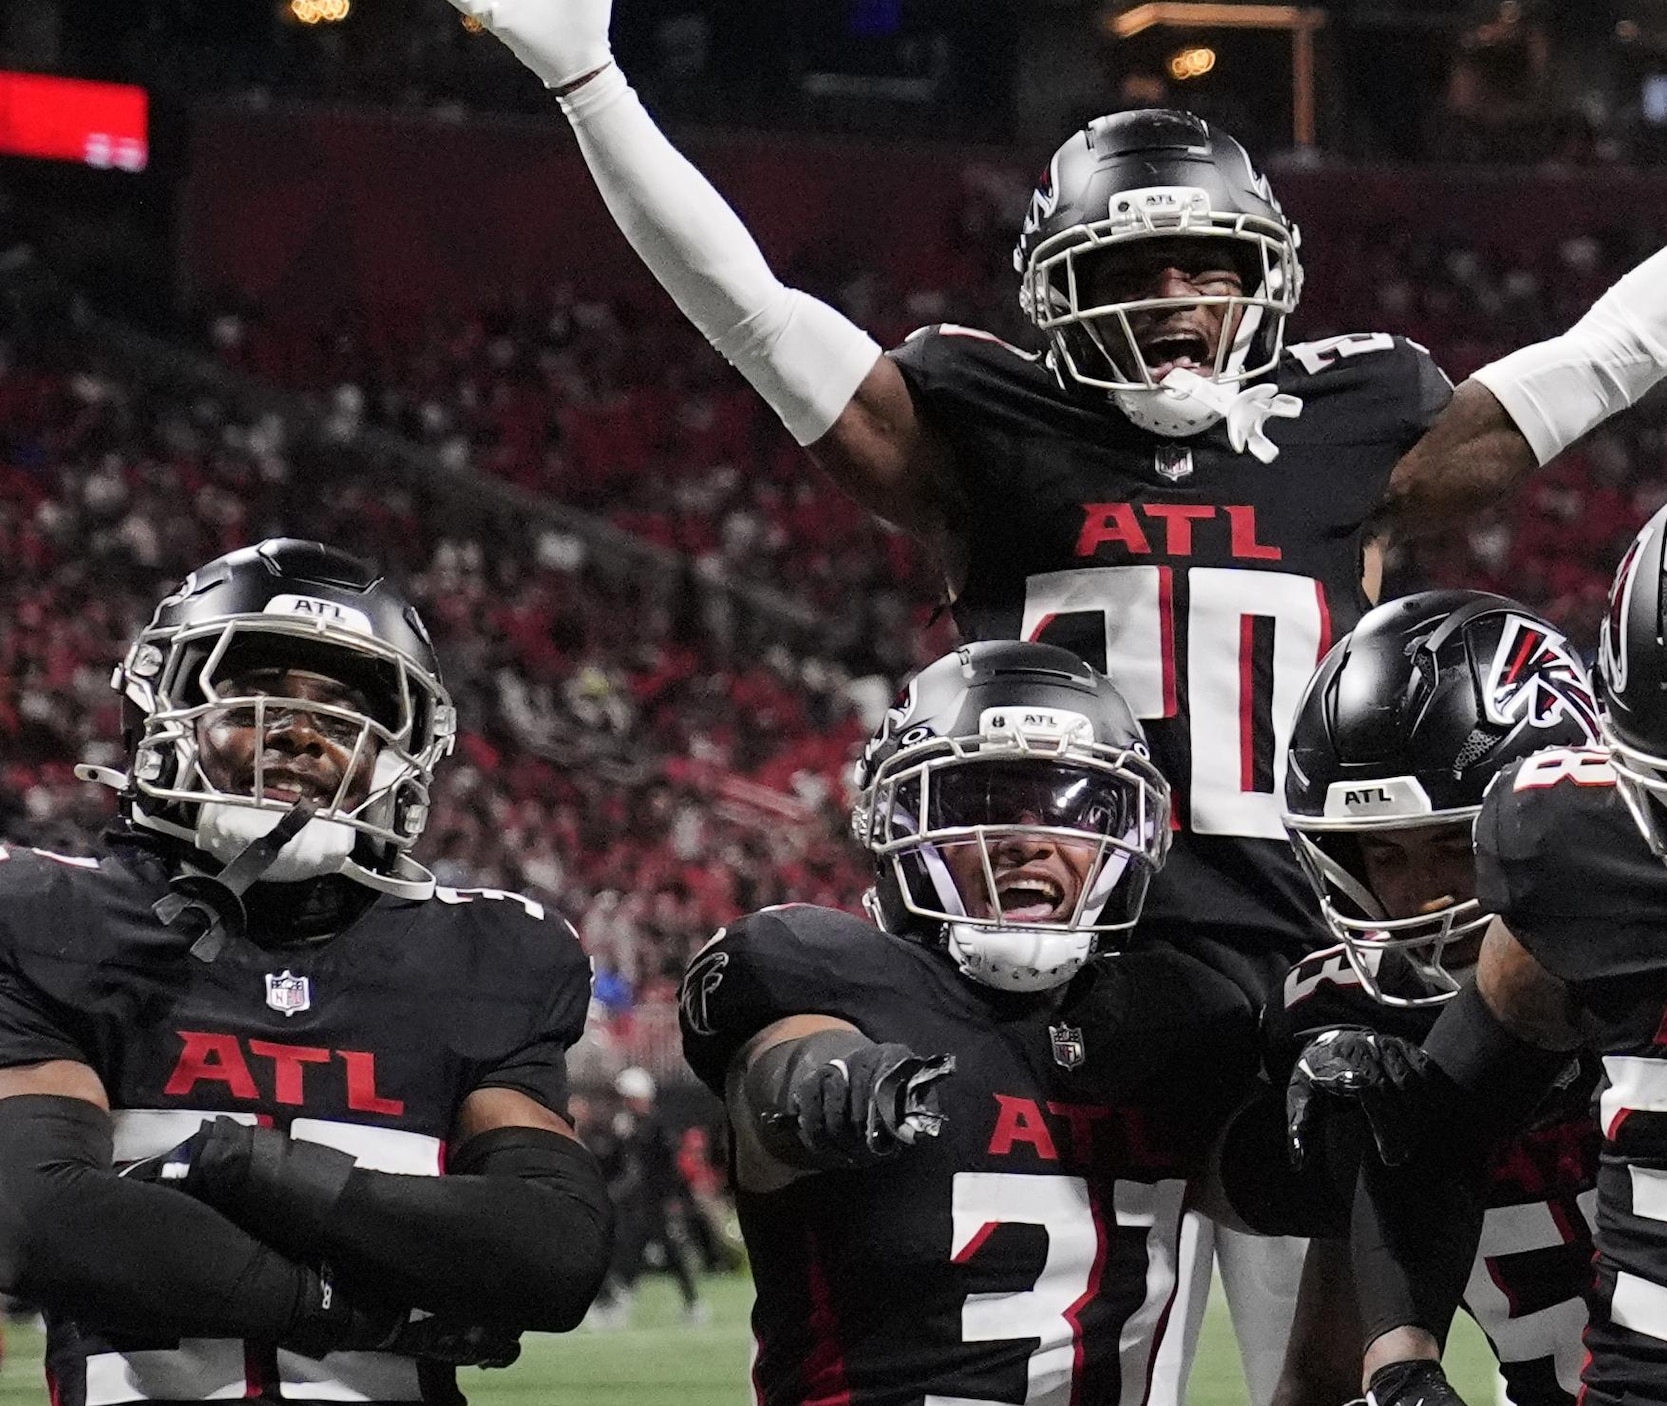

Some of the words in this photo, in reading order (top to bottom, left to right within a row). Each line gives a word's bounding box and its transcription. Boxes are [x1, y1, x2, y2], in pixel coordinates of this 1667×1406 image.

[1073, 502, 1283, 561] ATL
[293, 598, 346, 621] ATL
[1022, 712, 1059, 727] ATL
[1343, 787, 1392, 806] ATL
[163, 1030, 405, 1116] ATL
[988, 1094, 1172, 1167] ATL
